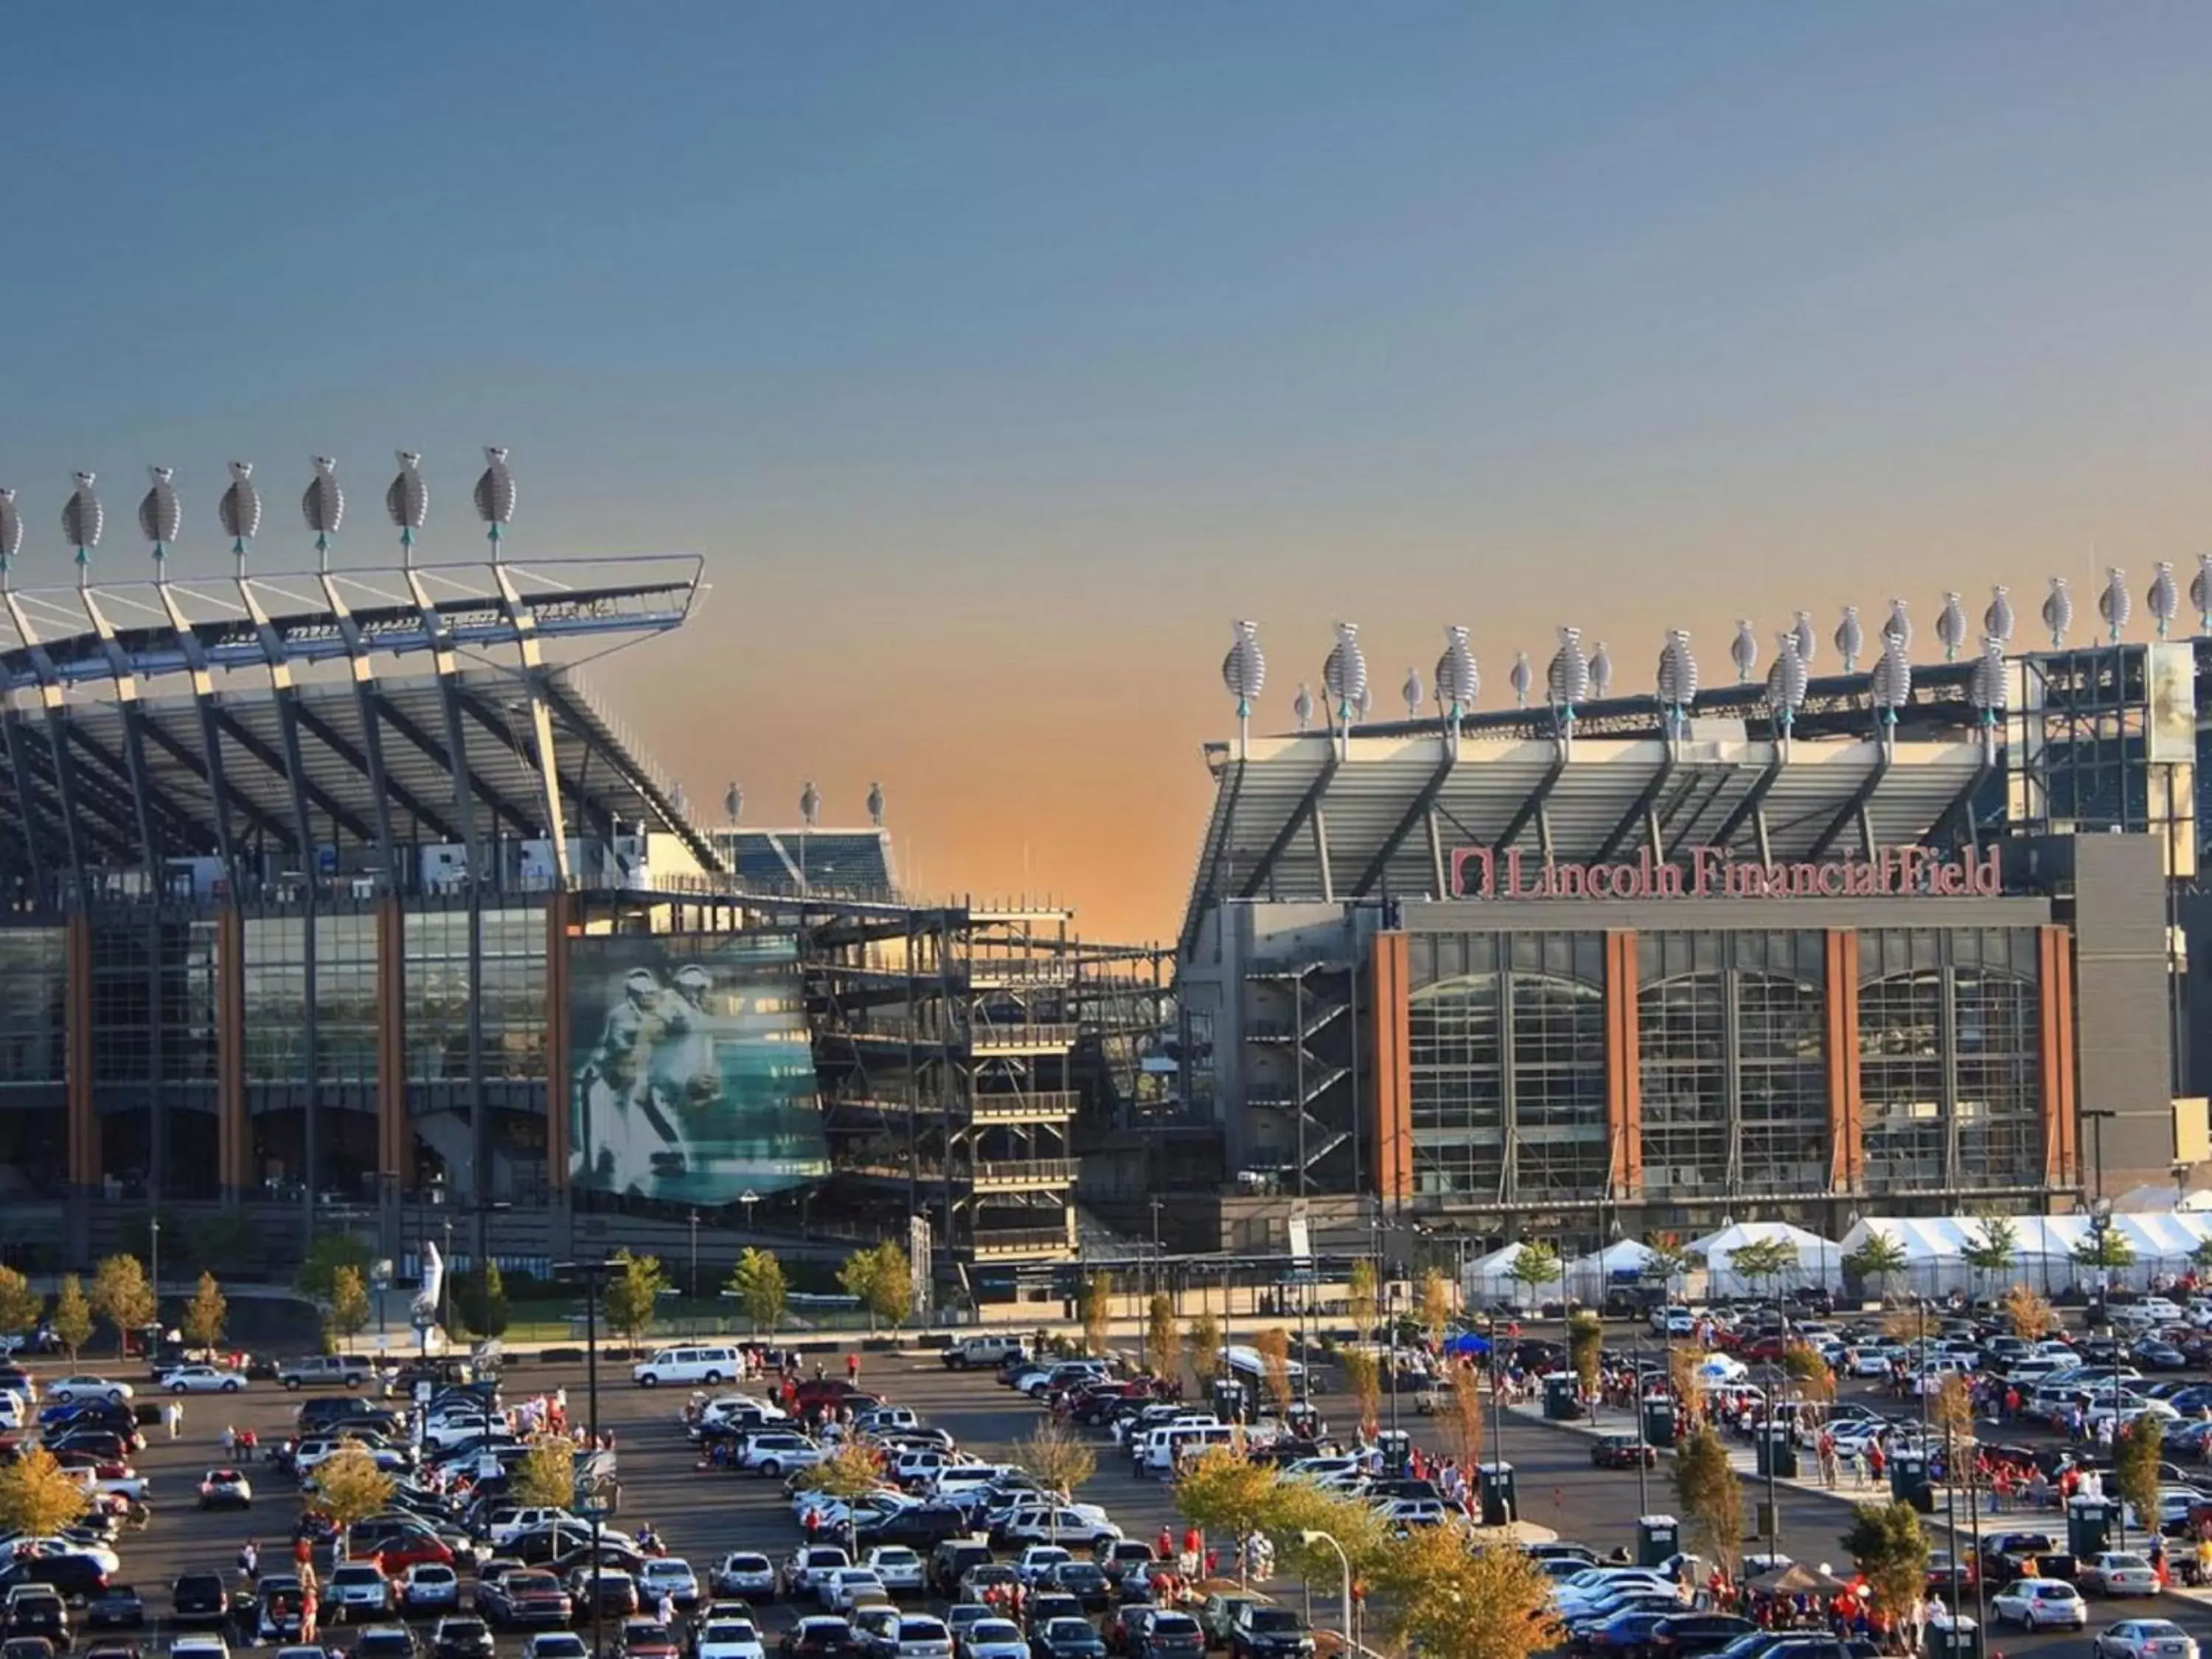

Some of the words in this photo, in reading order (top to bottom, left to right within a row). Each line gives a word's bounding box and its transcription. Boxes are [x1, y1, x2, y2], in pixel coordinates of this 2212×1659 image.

[1503, 844, 1686, 900] Lincoln
[1688, 844, 1892, 898] Financial
[1897, 844, 2003, 897] Field
